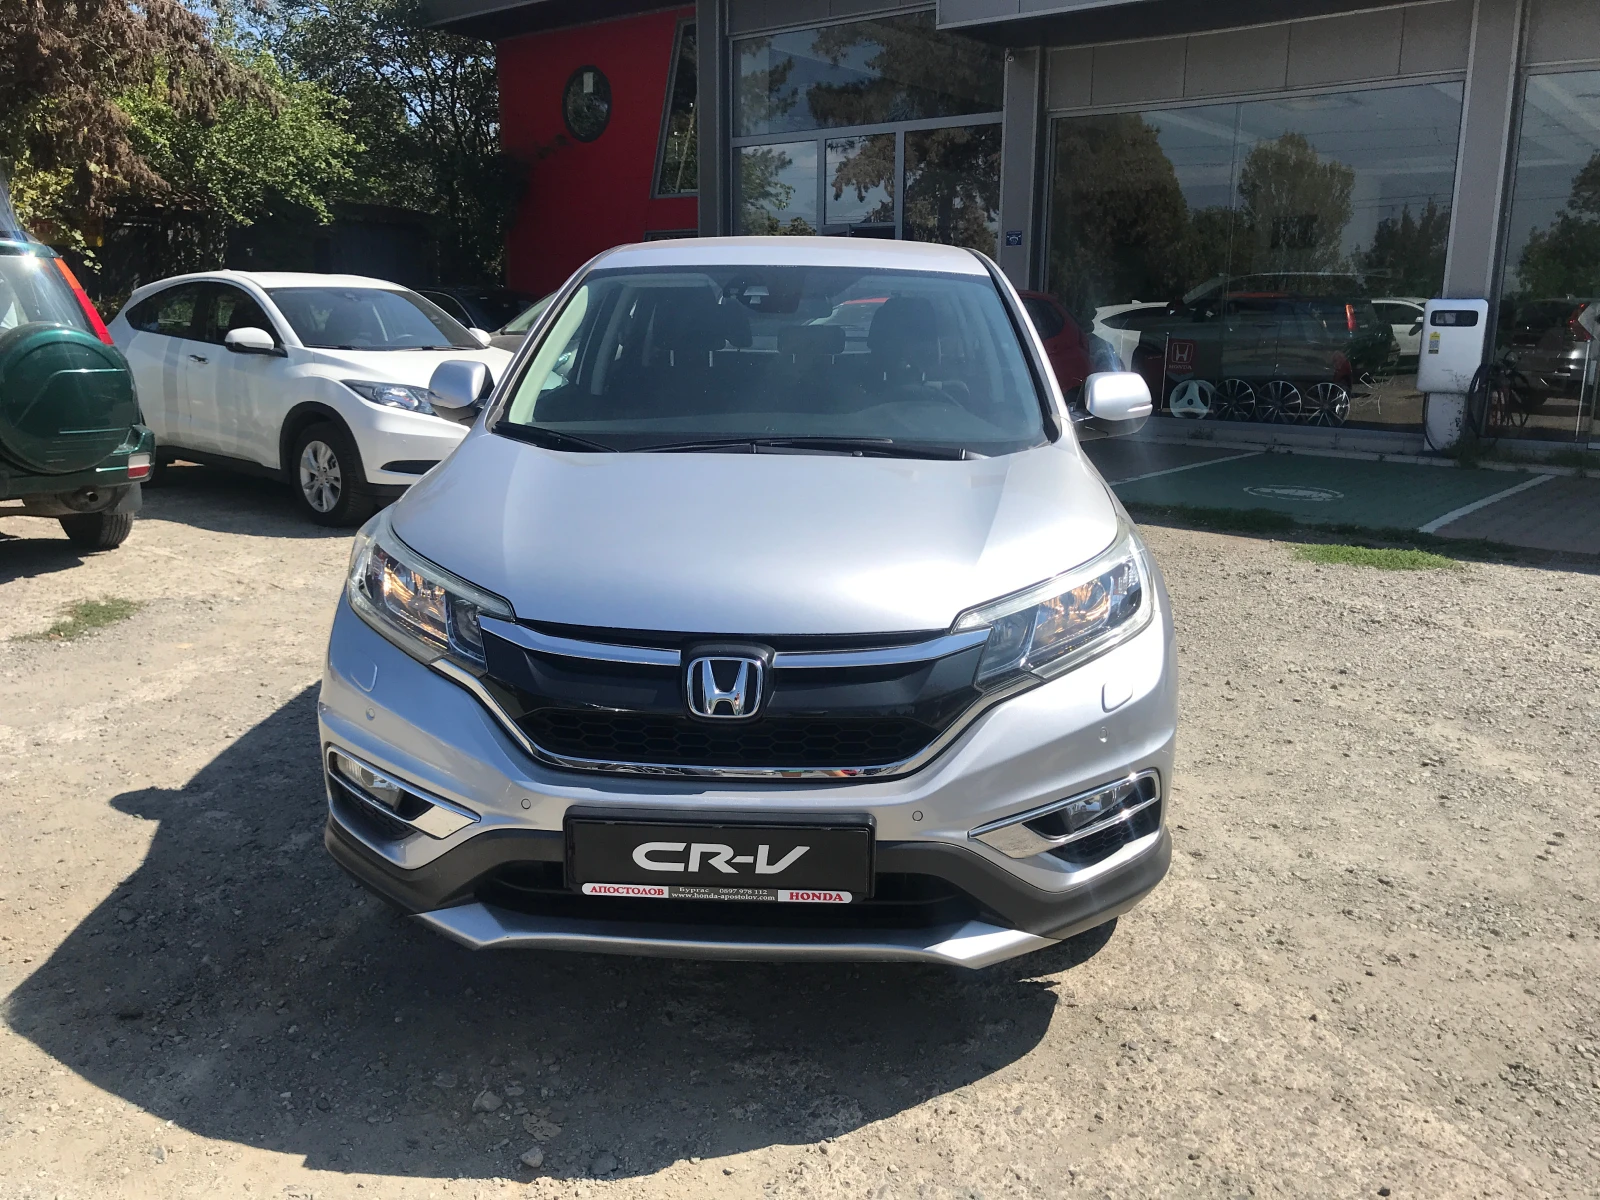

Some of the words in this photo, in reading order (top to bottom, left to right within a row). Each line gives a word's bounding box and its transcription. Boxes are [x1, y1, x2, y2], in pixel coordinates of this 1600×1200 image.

[632, 841, 811, 875] CR-V
[590, 885, 665, 896] АПОСТОЛОВ
[671, 892, 776, 901] www.honda-apostolov.com
[789, 891, 845, 902] HONDA
